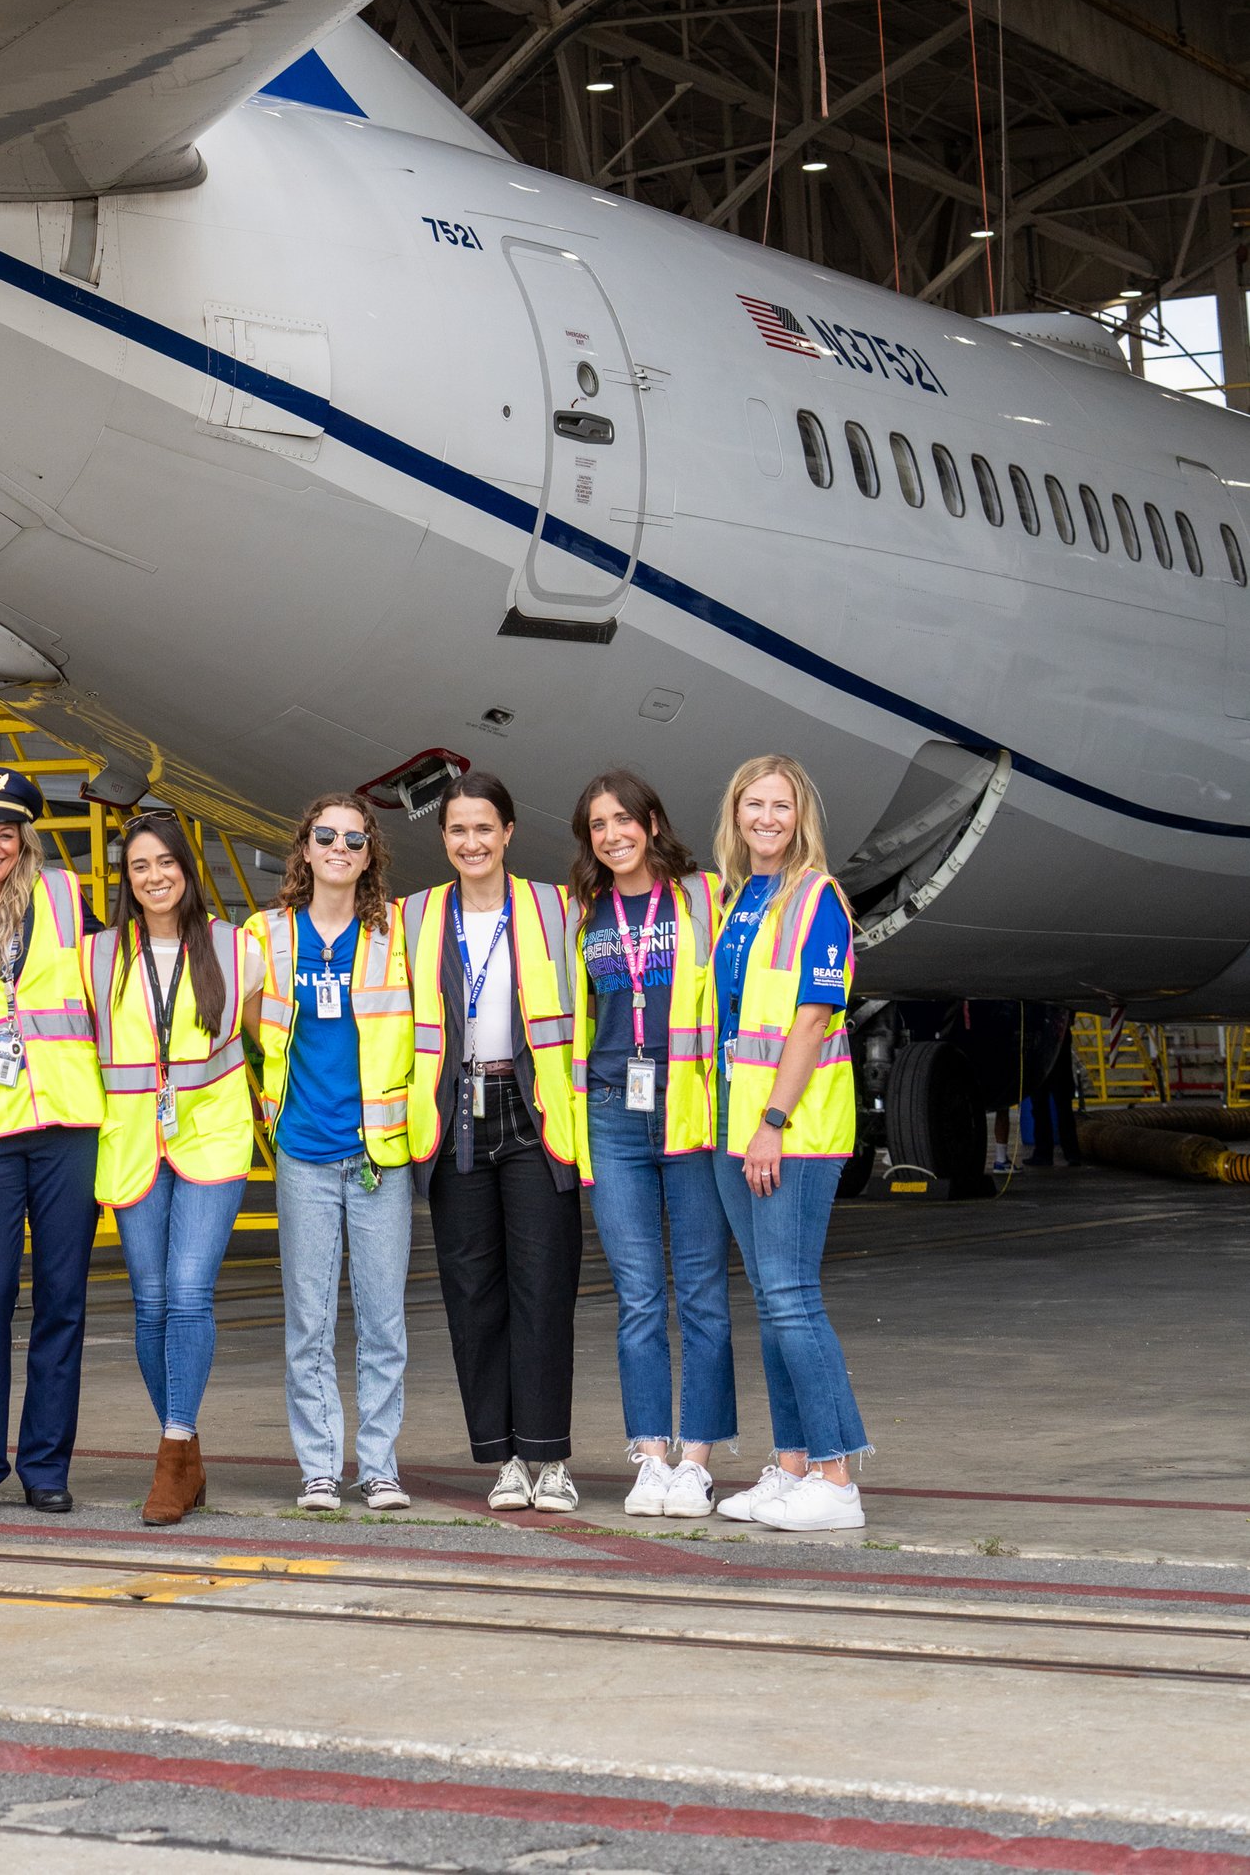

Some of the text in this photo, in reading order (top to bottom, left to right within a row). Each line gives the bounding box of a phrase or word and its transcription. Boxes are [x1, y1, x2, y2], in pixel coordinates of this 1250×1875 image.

[421, 216, 483, 251] 7521
[565, 330, 590, 340] EMERGENCY
[575, 338, 585, 346] EXIT
[806, 314, 948, 397] N37521
[111, 781, 125, 794] HOT
[453, 909, 462, 934] UNITED
[646, 904, 655, 926] UNITED
[490, 923, 504, 949] UNITED
[733, 952, 741, 979] UNITED
[813, 967, 843, 979] BEACO
[470, 976, 485, 1004] UNITED
